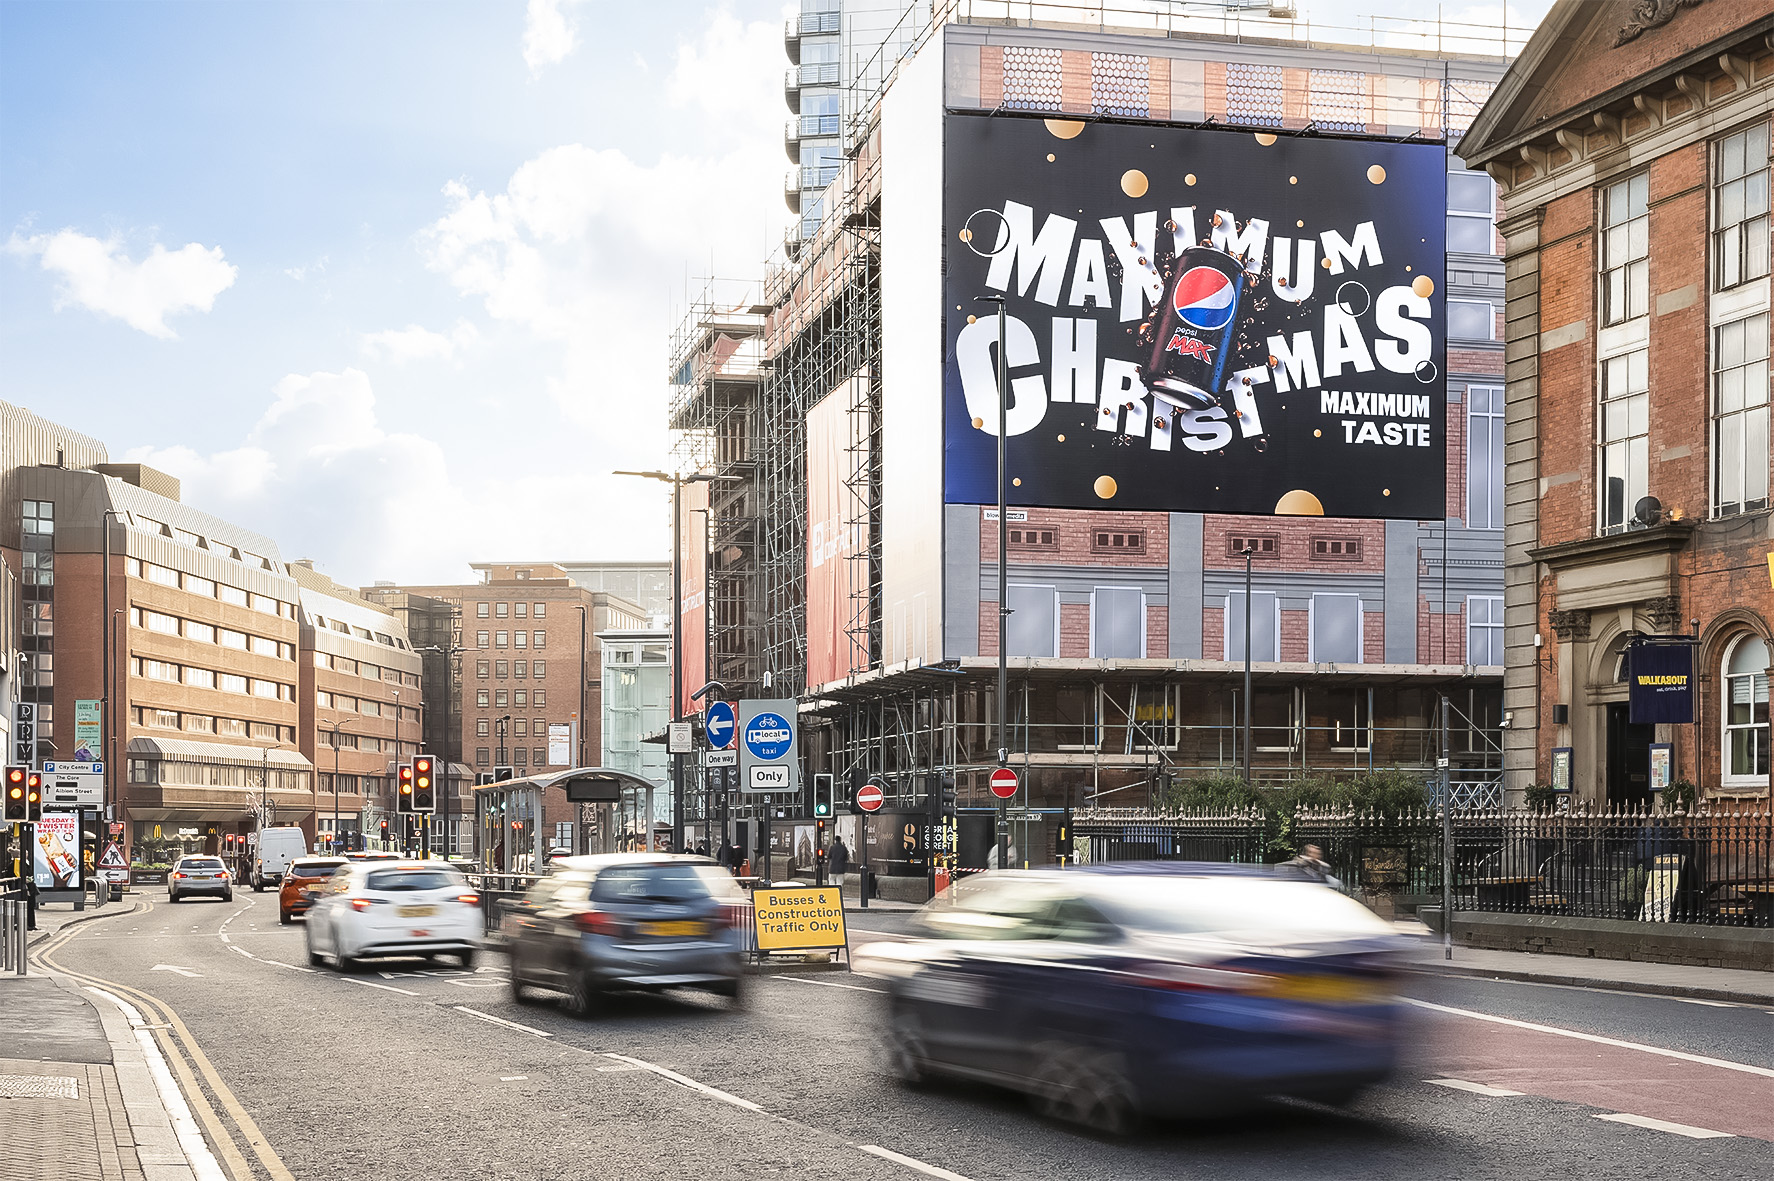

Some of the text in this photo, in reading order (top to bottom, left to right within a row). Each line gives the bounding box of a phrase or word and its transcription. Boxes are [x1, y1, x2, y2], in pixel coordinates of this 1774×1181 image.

[985, 200, 1384, 322] MAXIMUM
[1175, 326, 1198, 337] pepsi
[1165, 334, 1217, 365] MAX
[956, 285, 1433, 452] CHRISTMAS
[1321, 390, 1430, 418] MAXIMUM
[1341, 420, 1431, 447] TASTE
[1637, 675, 1688, 685] WALKABOUT
[761, 730, 781, 738] local
[708, 755, 735, 763] One way
[756, 771, 783, 782] Only
[769, 894, 827, 906] Busses &
[757, 907, 841, 920] Construction
[761, 920, 839, 934] Traffic Only
